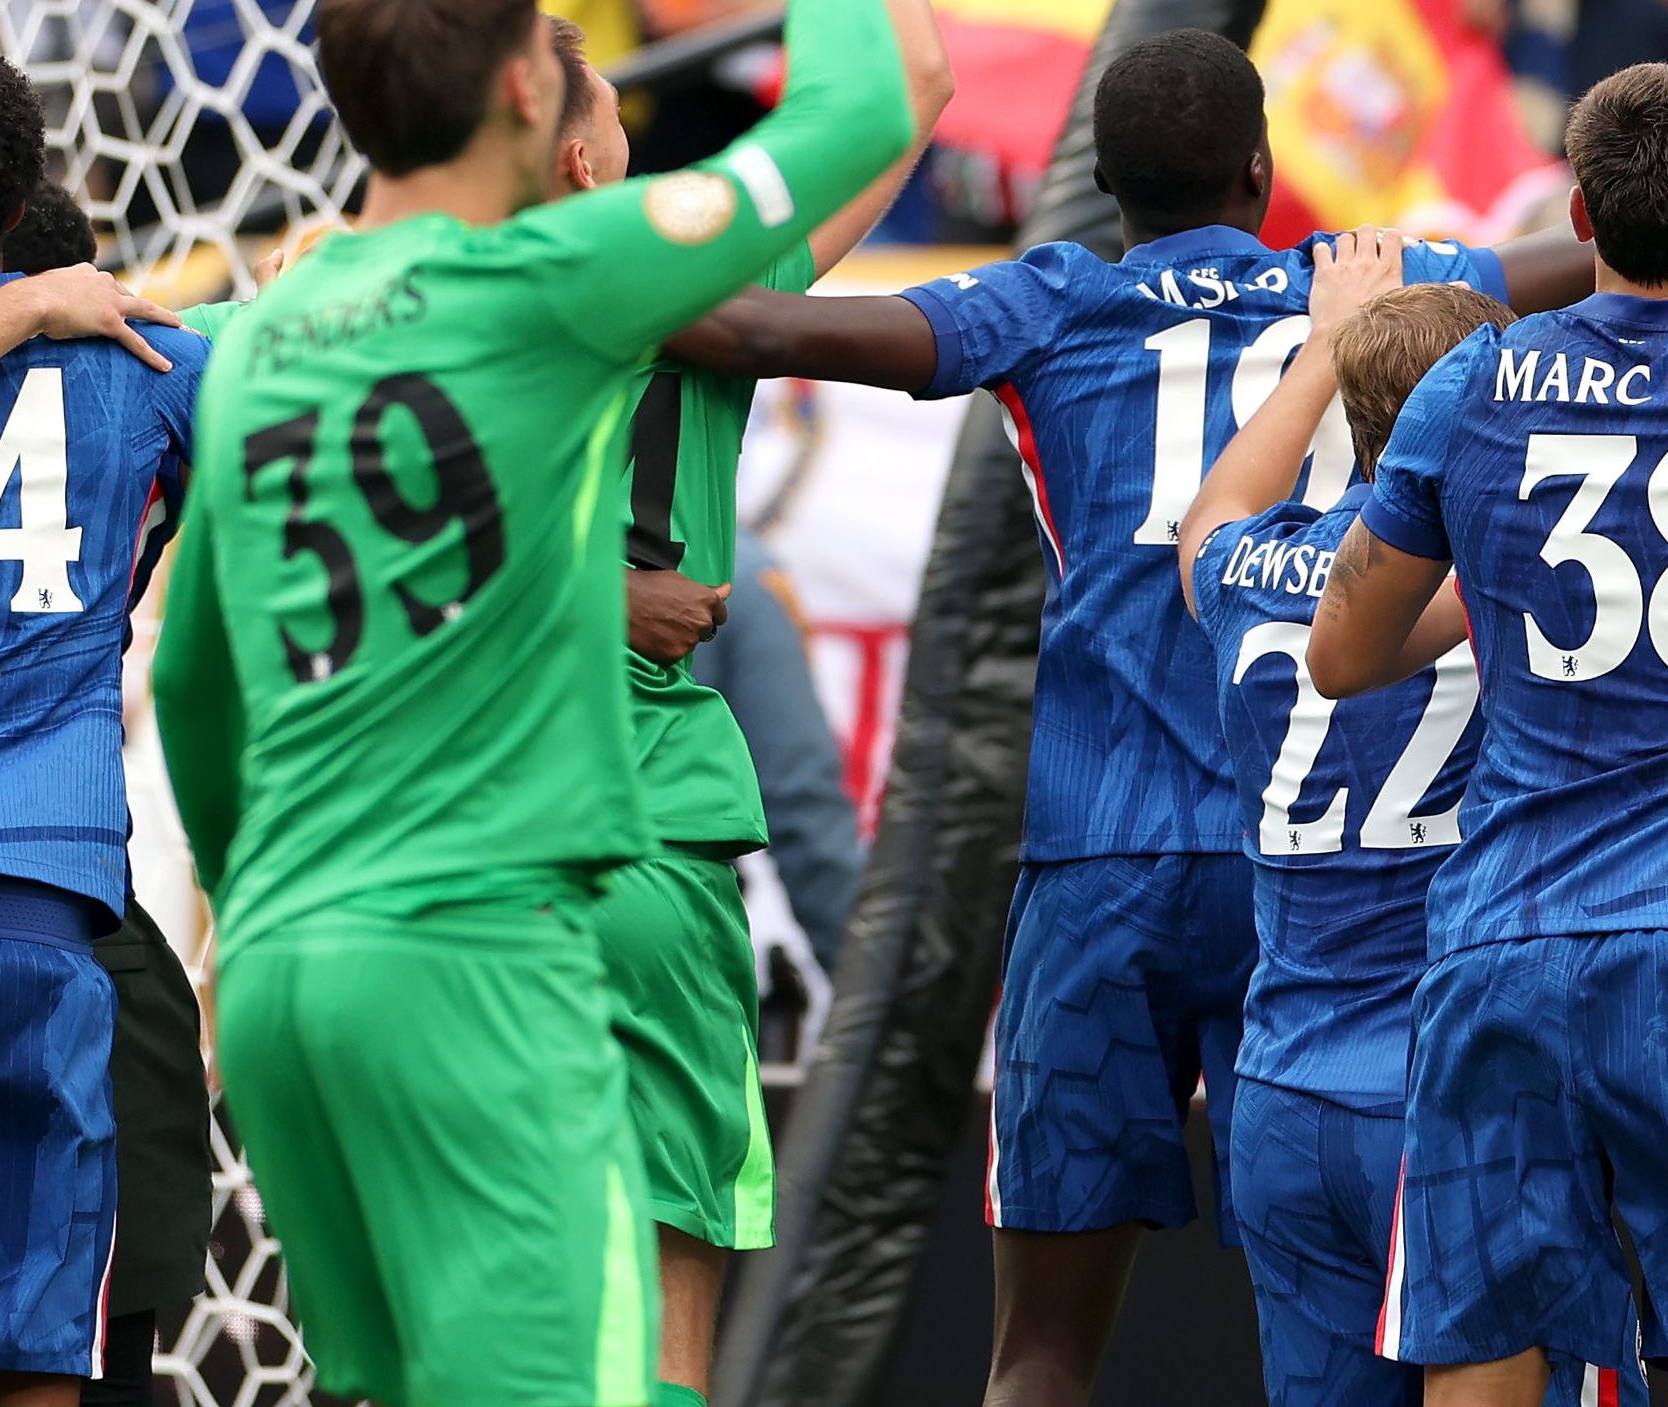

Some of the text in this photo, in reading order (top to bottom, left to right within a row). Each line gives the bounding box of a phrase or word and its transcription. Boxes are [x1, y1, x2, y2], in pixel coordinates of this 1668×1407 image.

[1492, 348, 1654, 407] MARC
[244, 372, 507, 685] 39
[1220, 534, 1337, 599] DEWSB
[1232, 618, 1484, 856] 22
